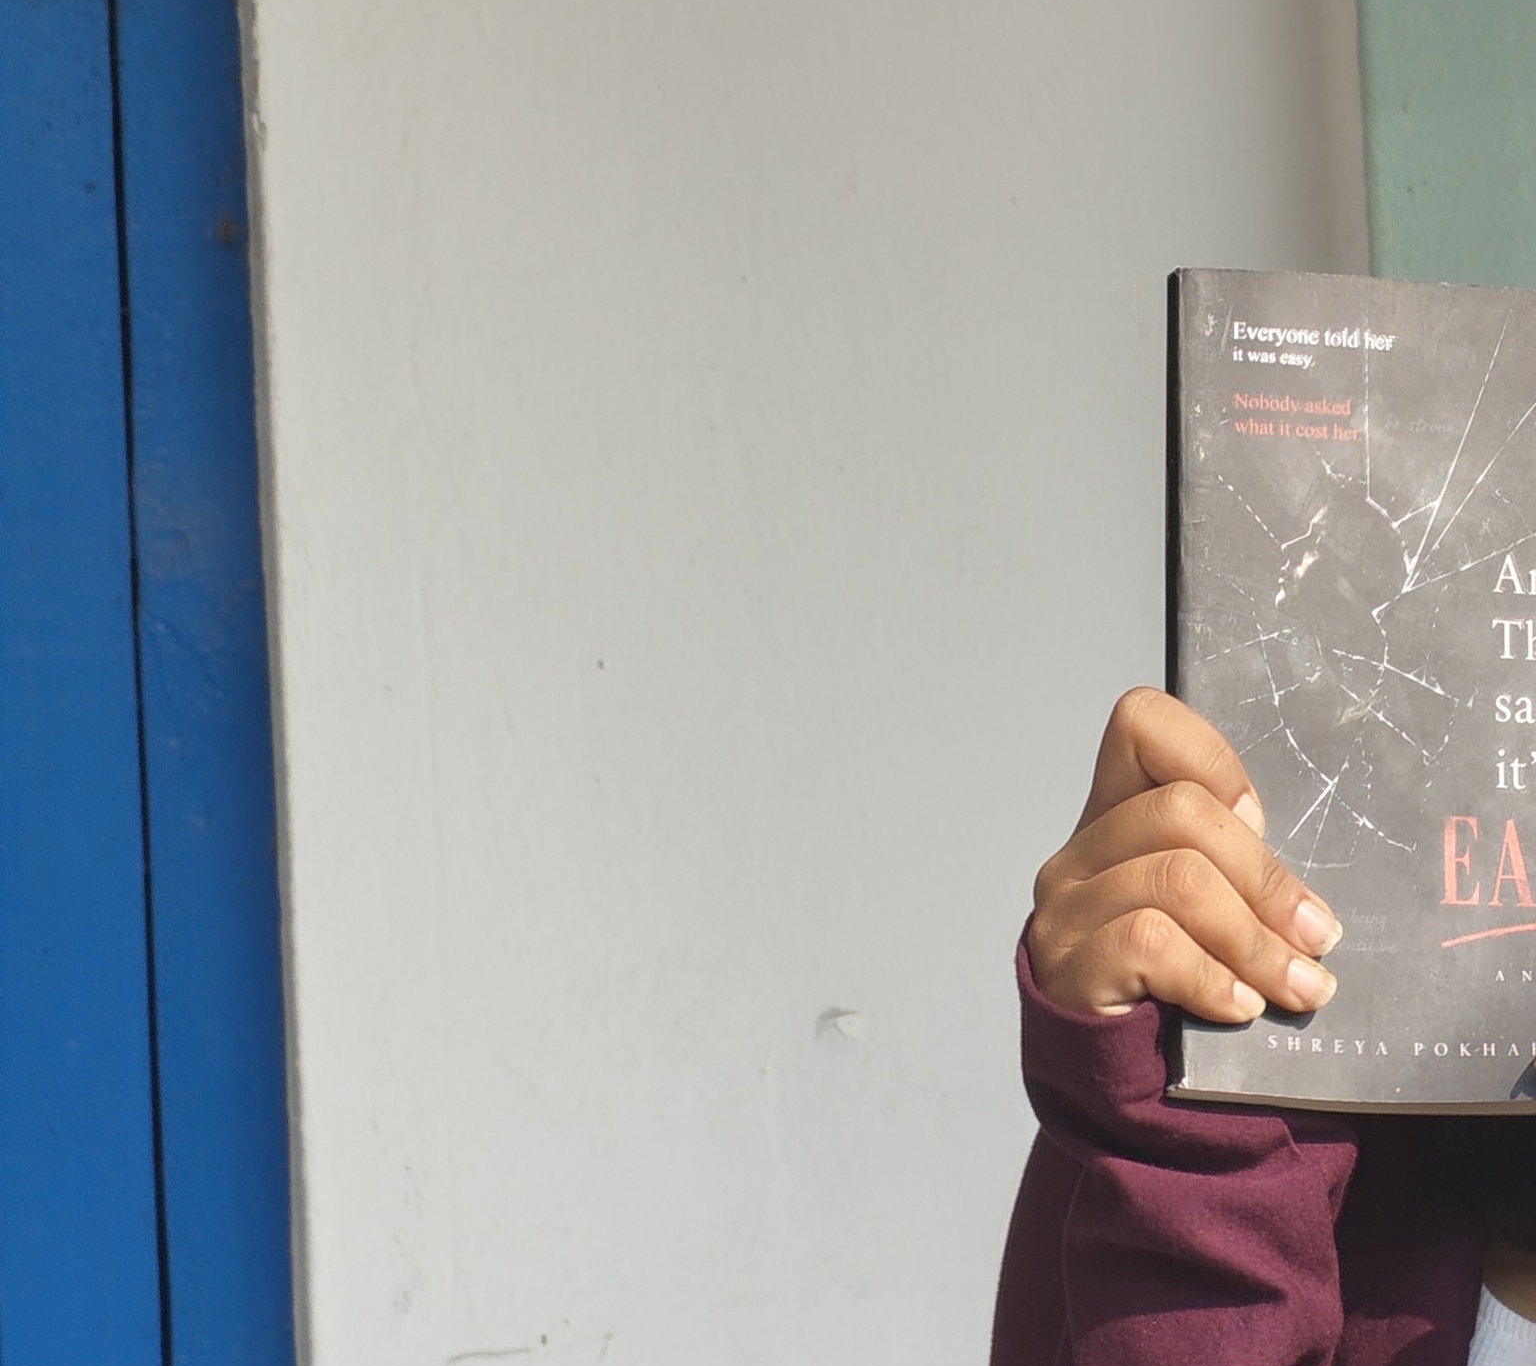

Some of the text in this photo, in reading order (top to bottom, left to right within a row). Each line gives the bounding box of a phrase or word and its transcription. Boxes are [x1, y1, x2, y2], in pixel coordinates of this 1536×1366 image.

[1232, 320, 1394, 351] Everyone told her
[1232, 345, 1244, 362] it
[1247, 349, 1276, 364] was
[1232, 393, 1352, 417] Nobody asked
[1234, 418, 1274, 436] what
[1279, 423, 1293, 438] it
[1296, 424, 1329, 439] cost
[1495, 969, 1506, 982] A
[1267, 1035, 1389, 1056] SHREYA
